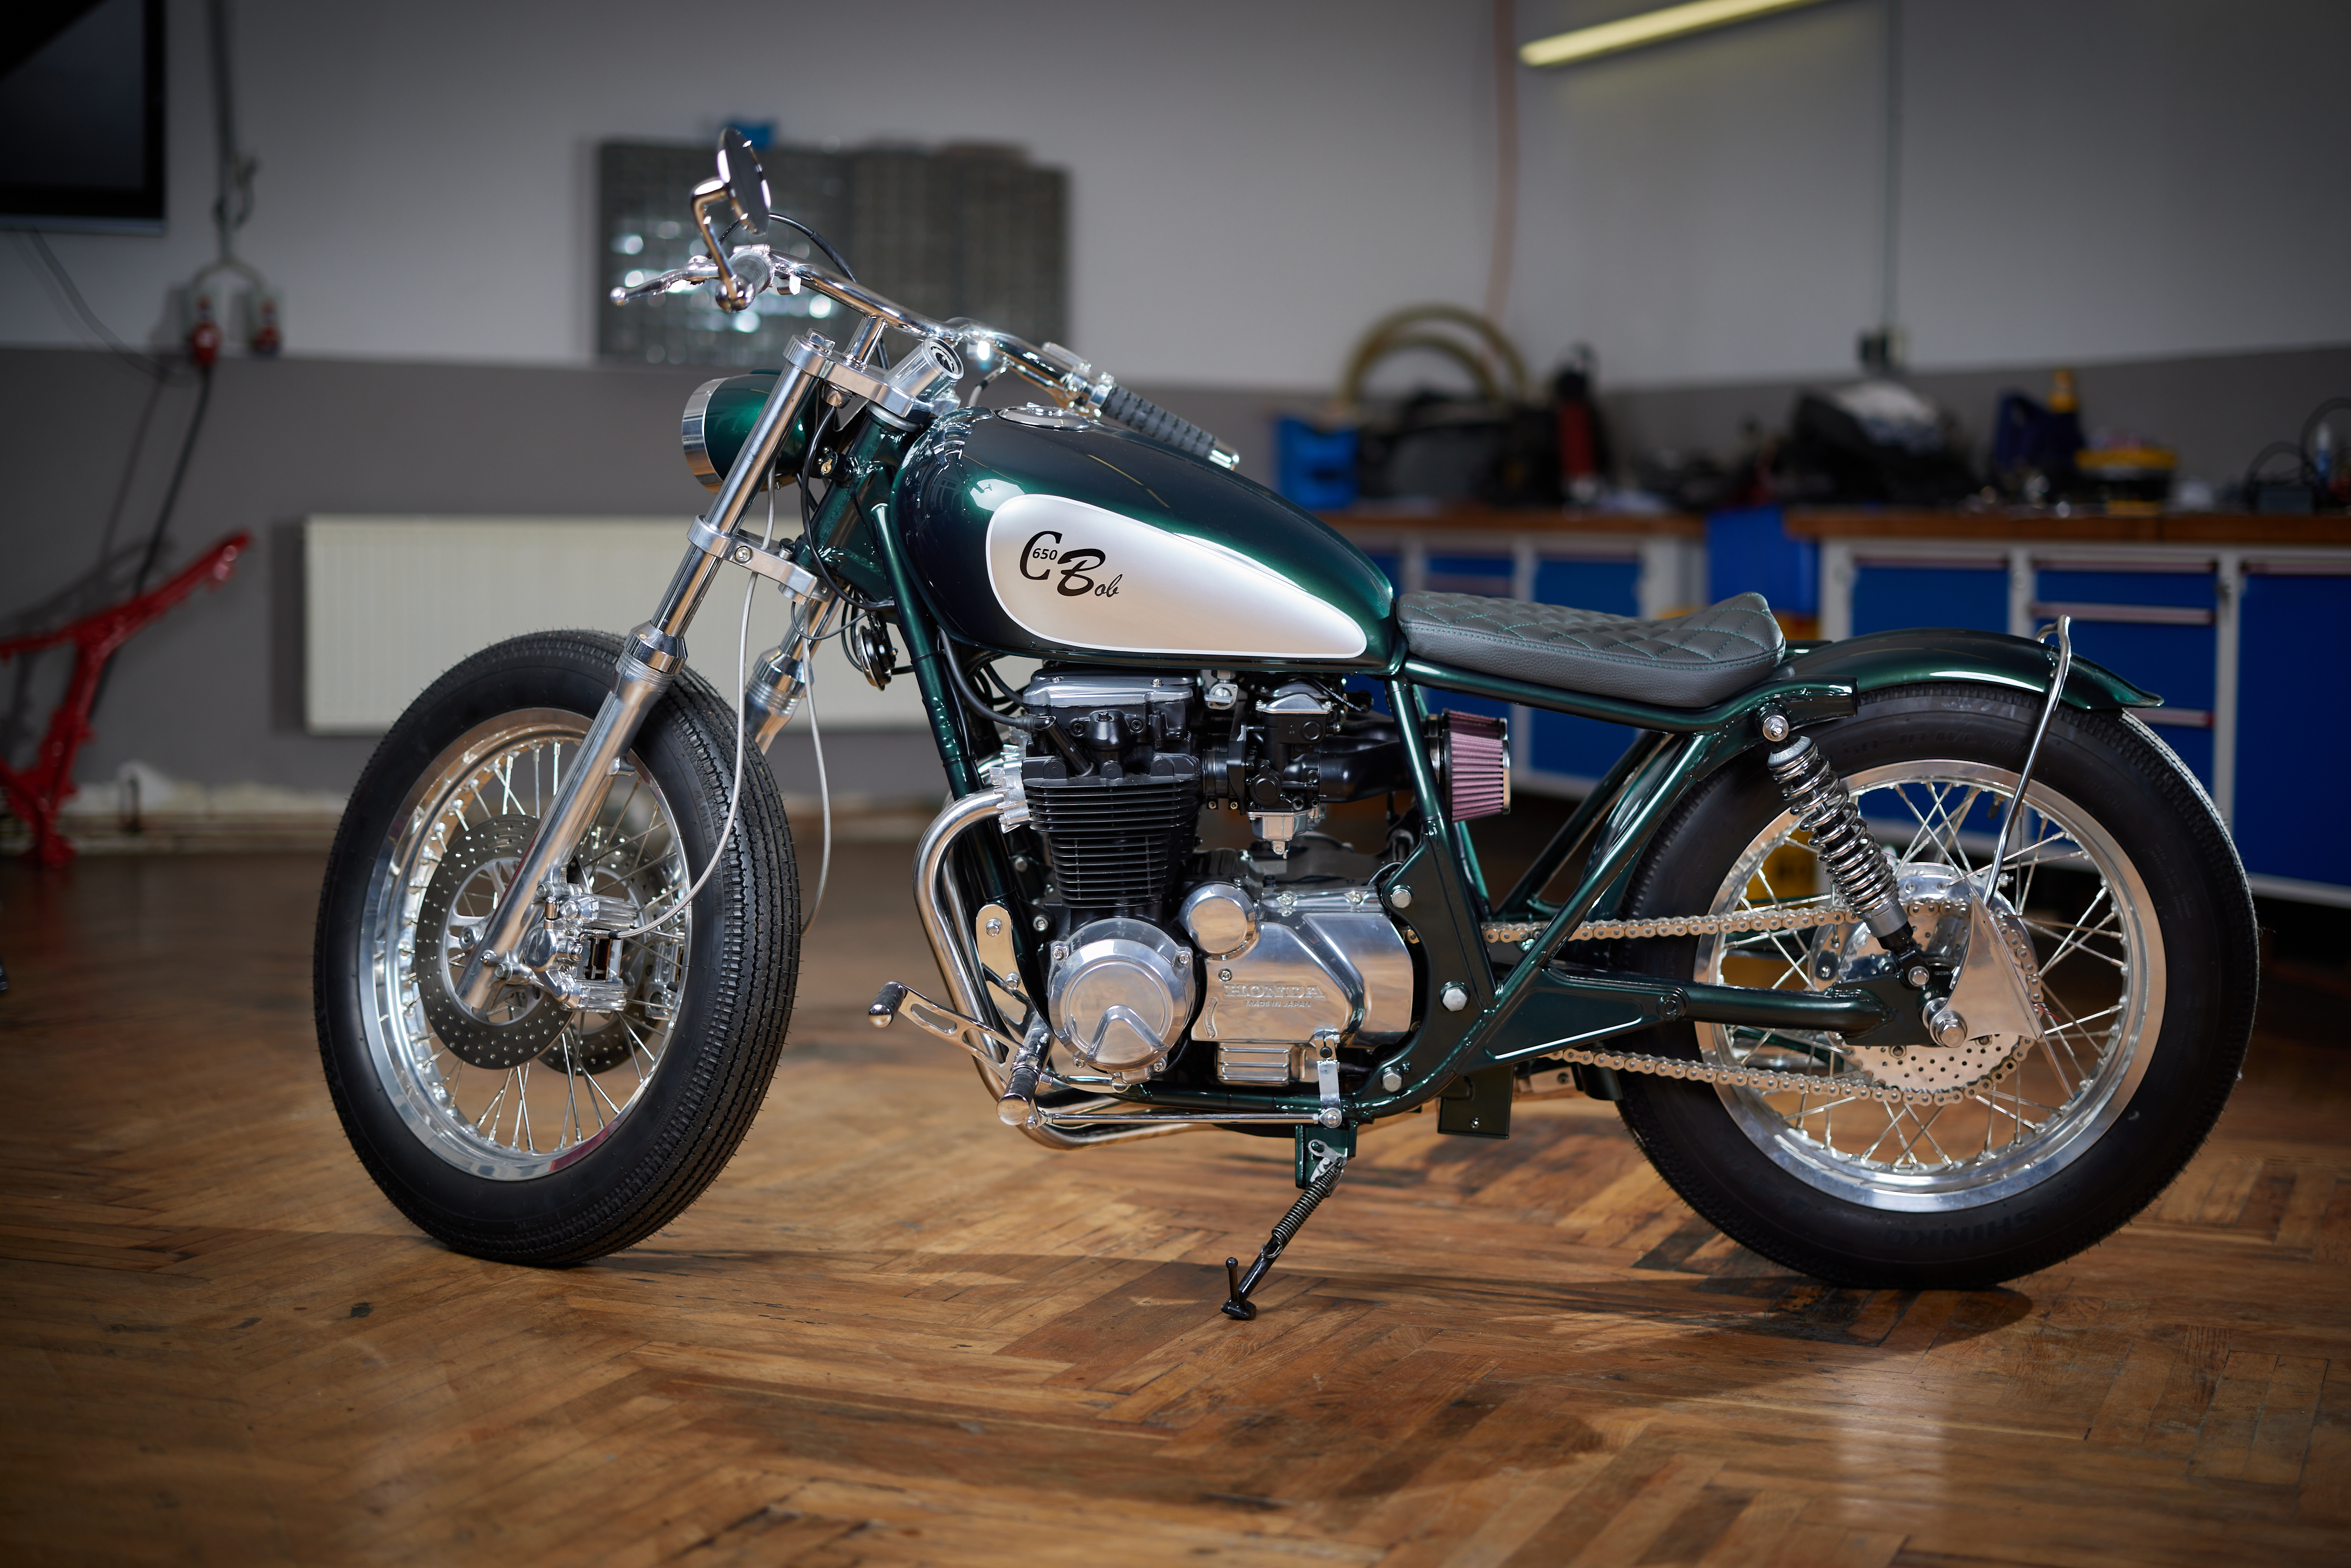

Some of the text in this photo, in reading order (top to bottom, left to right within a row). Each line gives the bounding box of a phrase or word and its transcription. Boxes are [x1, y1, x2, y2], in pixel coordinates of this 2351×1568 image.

[1032, 548, 1058, 560] 650
[1774, 741, 1806, 762] HAGON
[1224, 984, 1325, 999] HONDA
[1881, 1206, 2039, 1248] SHINKO
